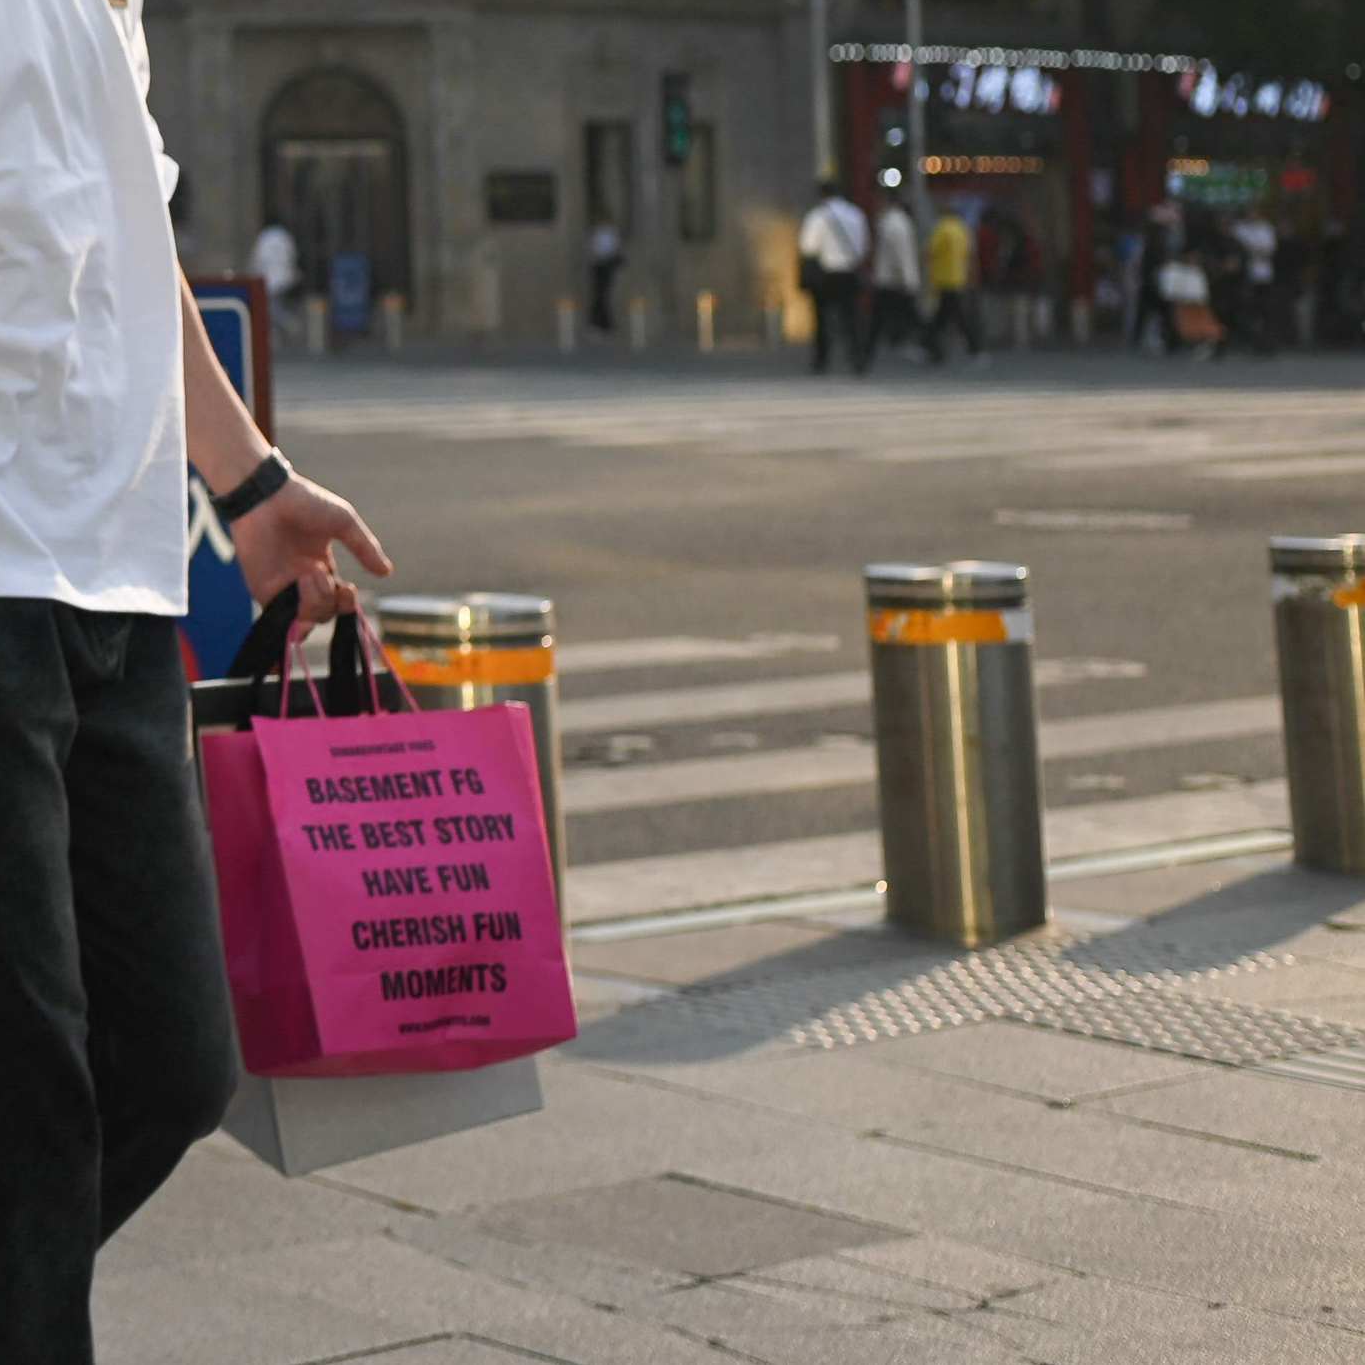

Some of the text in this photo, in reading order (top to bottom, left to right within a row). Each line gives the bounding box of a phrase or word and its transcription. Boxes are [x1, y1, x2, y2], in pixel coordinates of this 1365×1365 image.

[305, 769, 443, 804] BASEMENT
[302, 813, 515, 851] THE BEST STORY
[362, 863, 491, 898] HAVE FUN
[351, 911, 523, 951] CHERISH FUN
[380, 962, 508, 1002] MOMENTS
